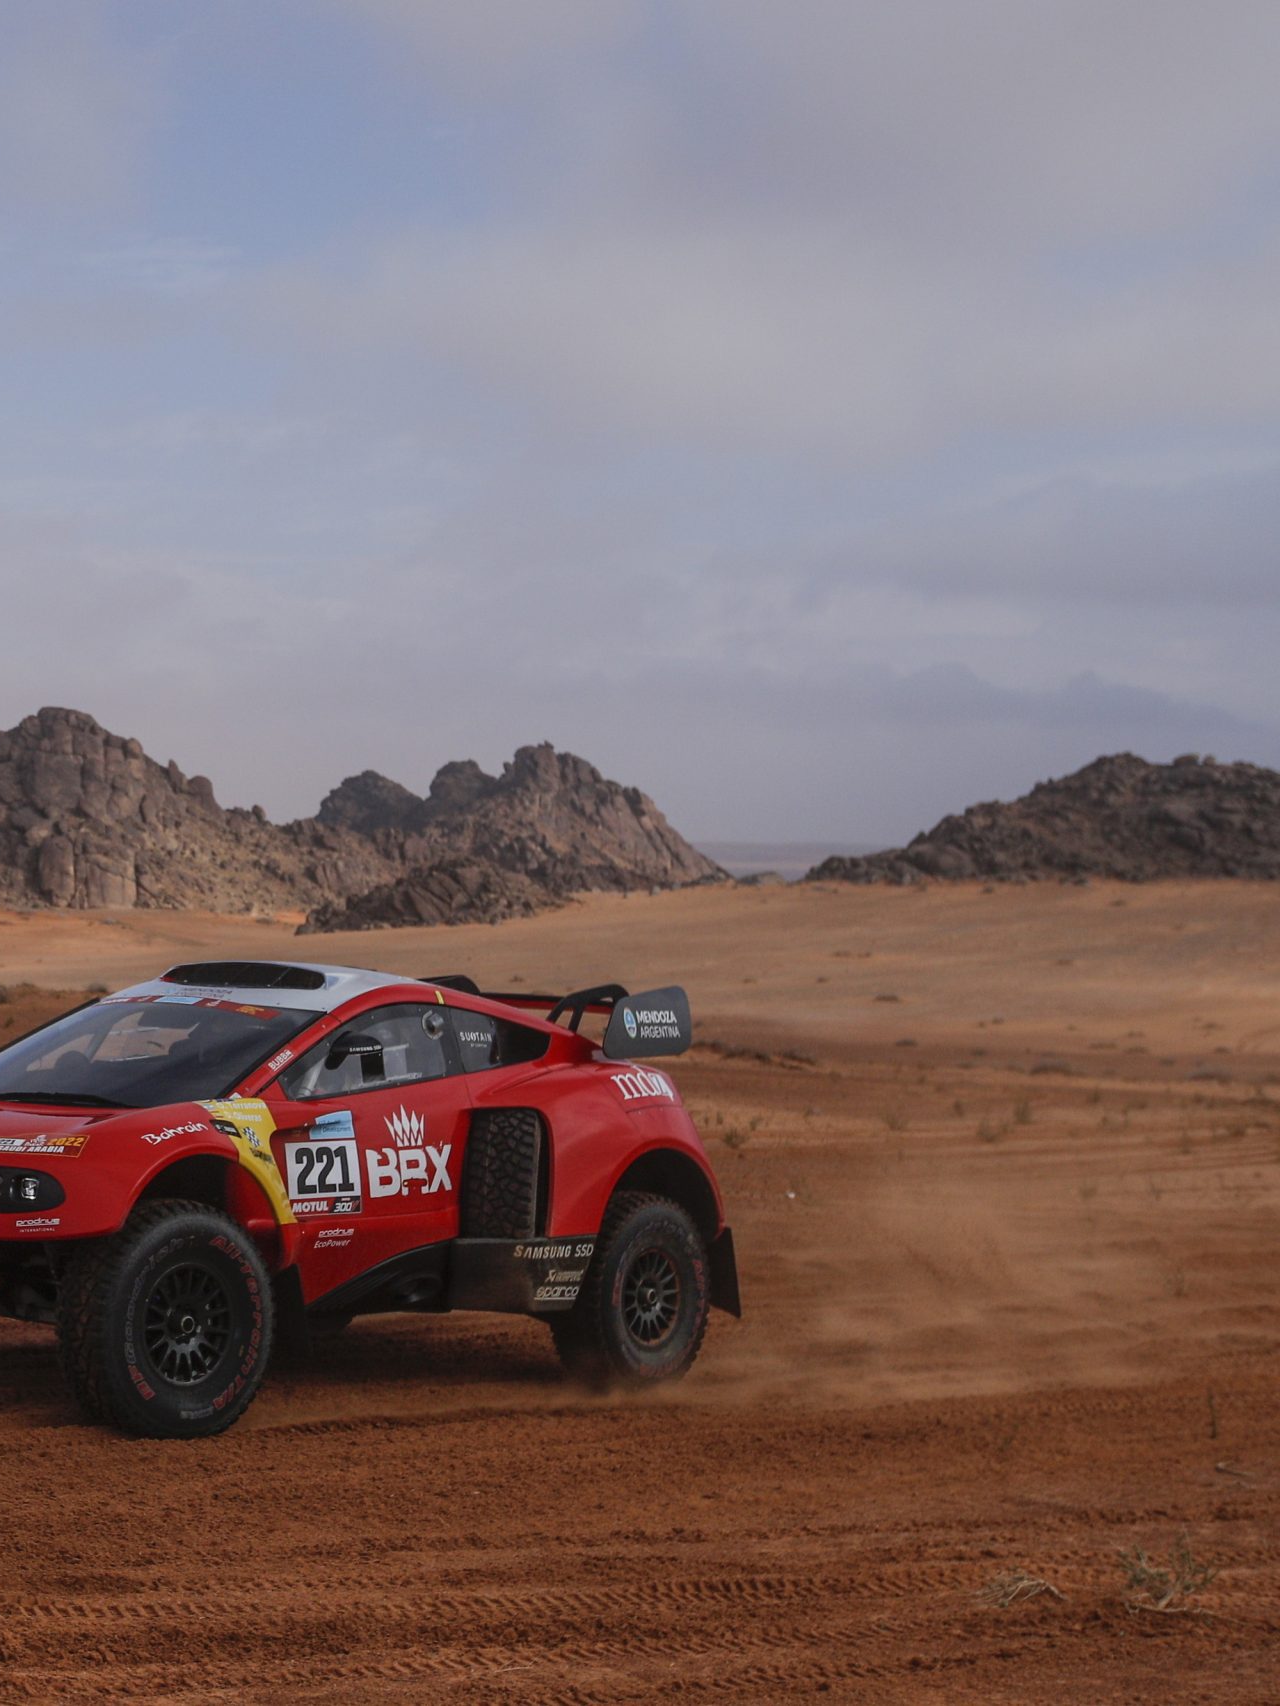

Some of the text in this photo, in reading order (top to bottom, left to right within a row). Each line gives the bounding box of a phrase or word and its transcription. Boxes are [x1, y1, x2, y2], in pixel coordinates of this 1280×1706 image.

[636, 1010, 677, 1024] MENDOZA
[640, 1025, 680, 1039] ARGENTINA
[140, 1121, 209, 1145] Bahrain
[27, 1145, 65, 1153] ARABIA
[47, 1137, 84, 1147] 2022
[294, 1145, 355, 1195] 221
[365, 1144, 452, 1198] BRX
[292, 1200, 329, 1213] MOTUL
[314, 1238, 351, 1249] EcoPower
[513, 1243, 594, 1260] SAMSUNG SSD
